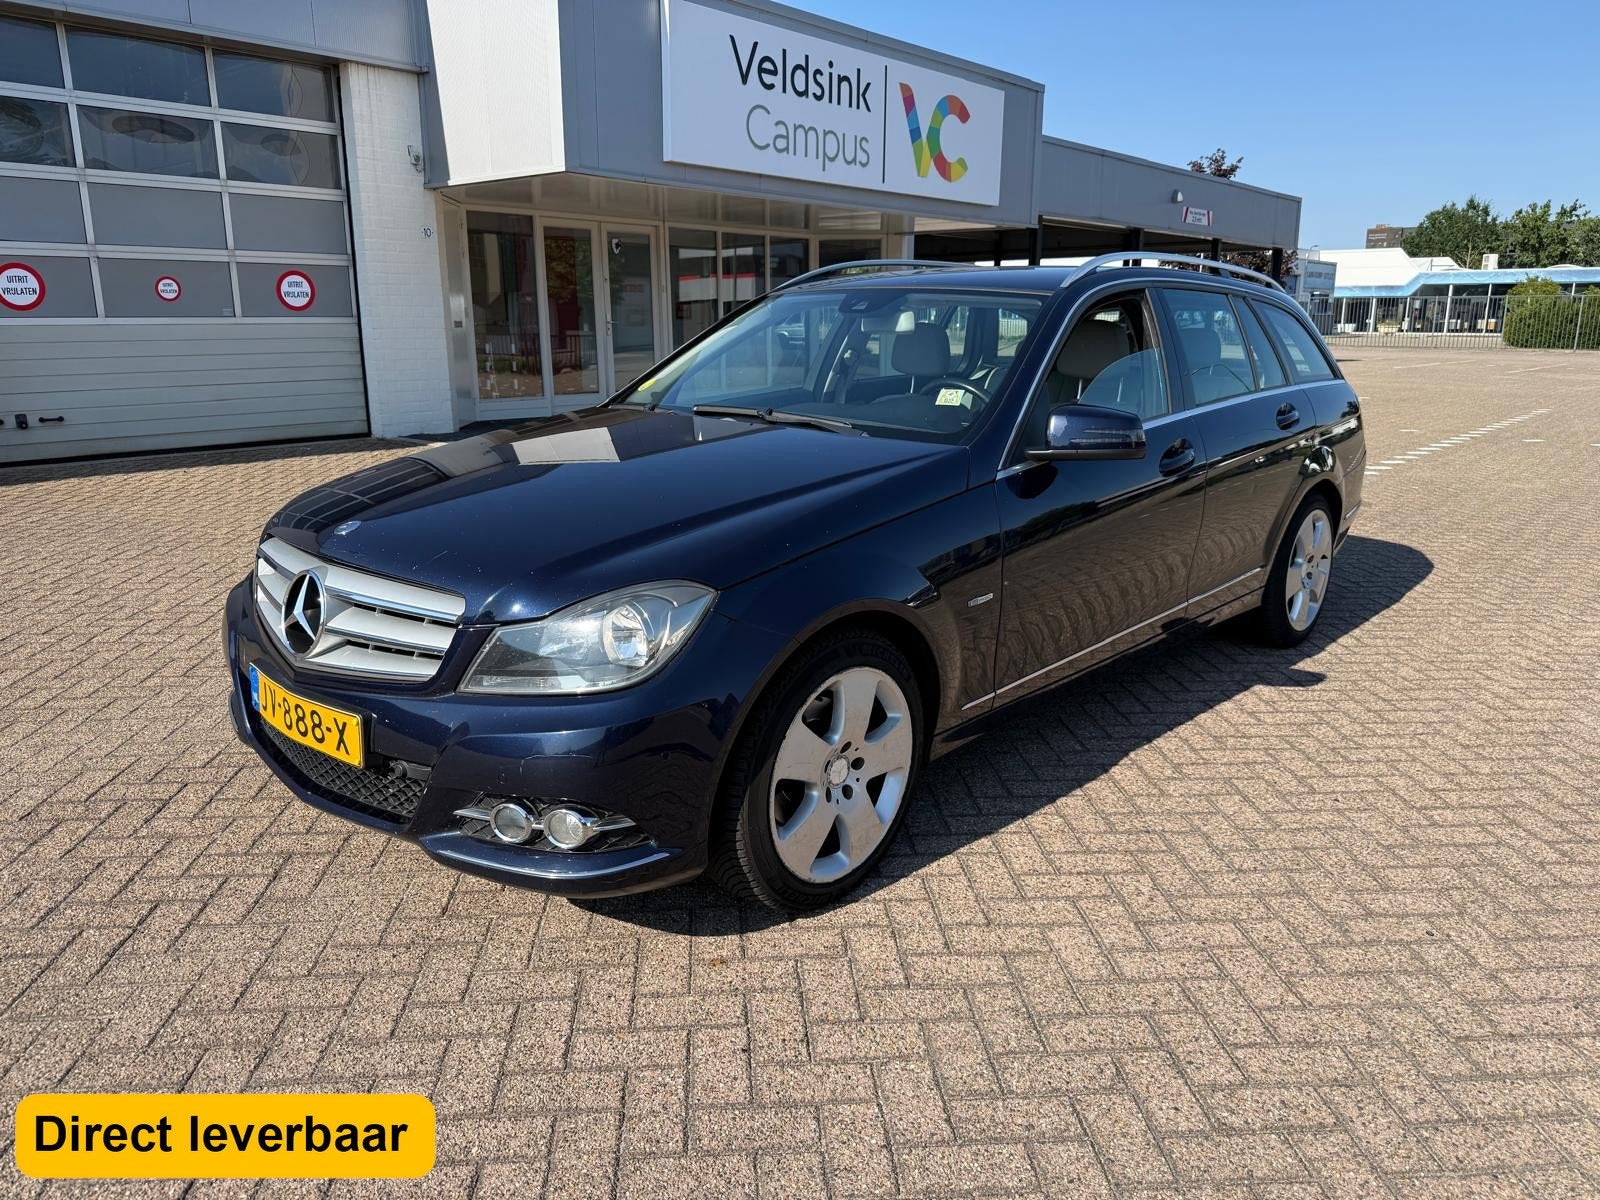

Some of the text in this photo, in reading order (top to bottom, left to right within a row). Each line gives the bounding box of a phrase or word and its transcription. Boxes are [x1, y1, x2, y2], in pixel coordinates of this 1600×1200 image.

[729, 34, 871, 112] Veldsink
[746, 104, 870, 171] Campus
[899, 82, 970, 183] VC
[1, 287, 37, 295] VRIJLATEN
[6, 275, 28, 284] UITRIT
[287, 280, 303, 288] UITRIT
[262, 682, 350, 755] JV-888-X
